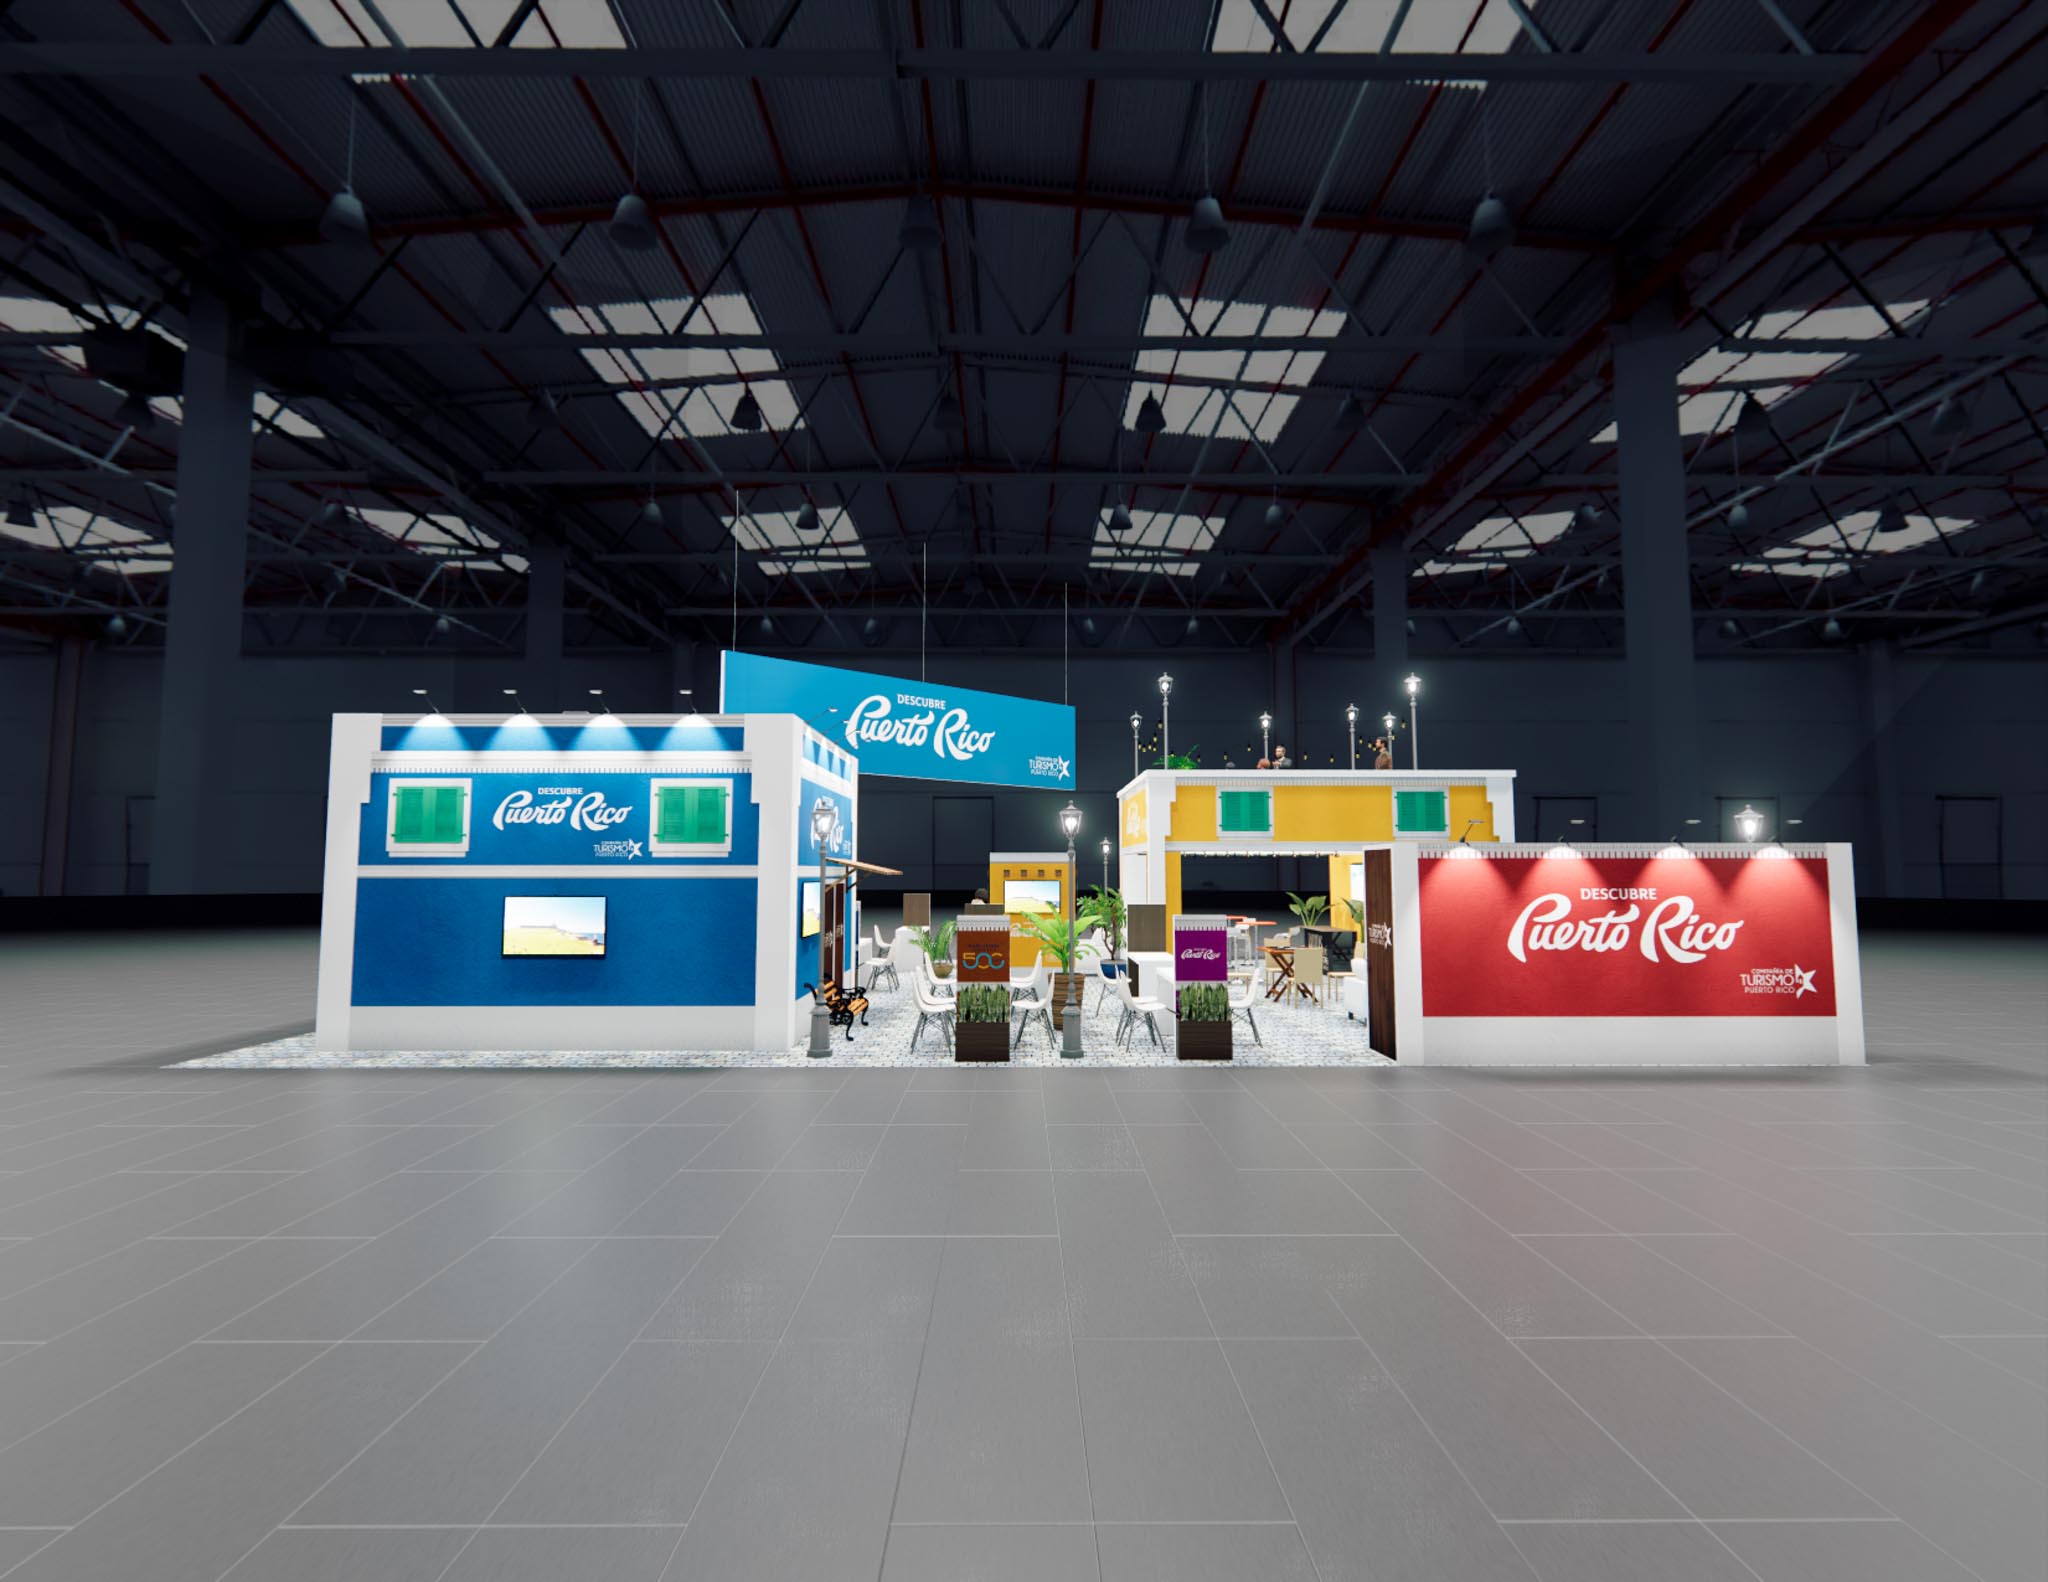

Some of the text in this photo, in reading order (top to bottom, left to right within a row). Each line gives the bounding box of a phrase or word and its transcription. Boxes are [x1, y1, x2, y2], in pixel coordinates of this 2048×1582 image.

[897, 693, 946, 710] DESCUBRE
[845, 695, 996, 761] Puerto Rico
[538, 787, 584, 795] DESCUBRE
[492, 790, 633, 832] Puerto Rico
[1580, 887, 1657, 900] DESCUBRE
[1507, 893, 1744, 964] Puerto Rico
[1739, 973, 1795, 986] TURISMO
[1744, 986, 1795, 994] PUERTO RICO
